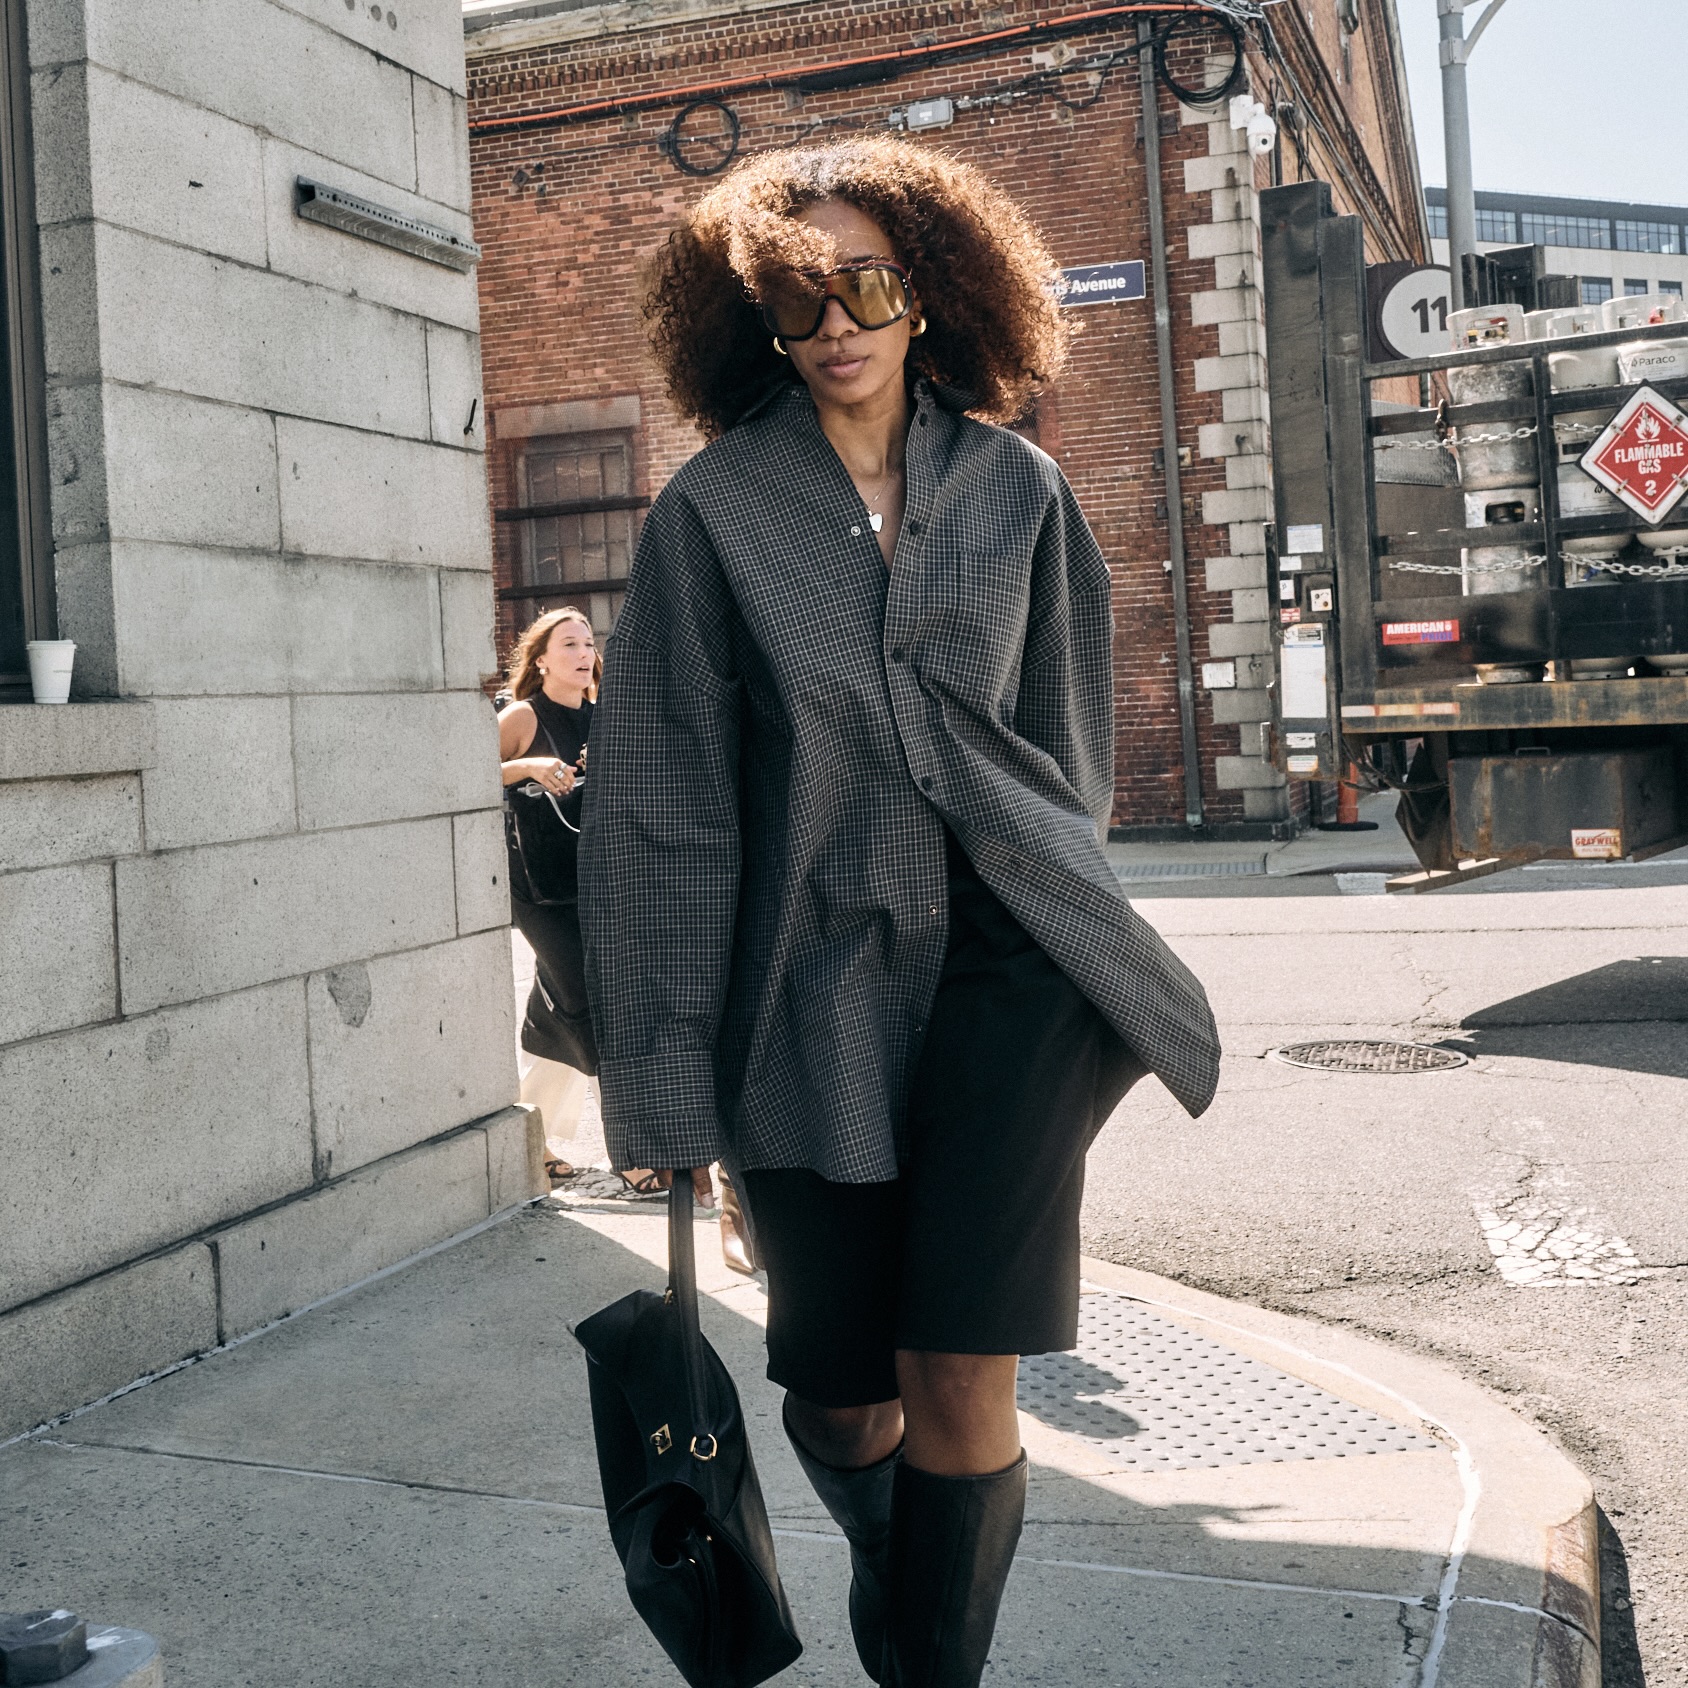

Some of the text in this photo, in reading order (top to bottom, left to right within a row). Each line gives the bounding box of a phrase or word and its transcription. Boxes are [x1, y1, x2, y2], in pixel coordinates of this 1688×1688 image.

[1071, 277, 1126, 294] Avenue
[1411, 296, 1448, 333] 11
[1639, 355, 1676, 366] Paraco
[1614, 442, 1684, 463] FLAMMABLE
[1637, 459, 1661, 474] GAS
[1645, 480, 1657, 496] 2
[1386, 621, 1444, 634] AMERICAN
[1421, 631, 1453, 641] PRIDE
